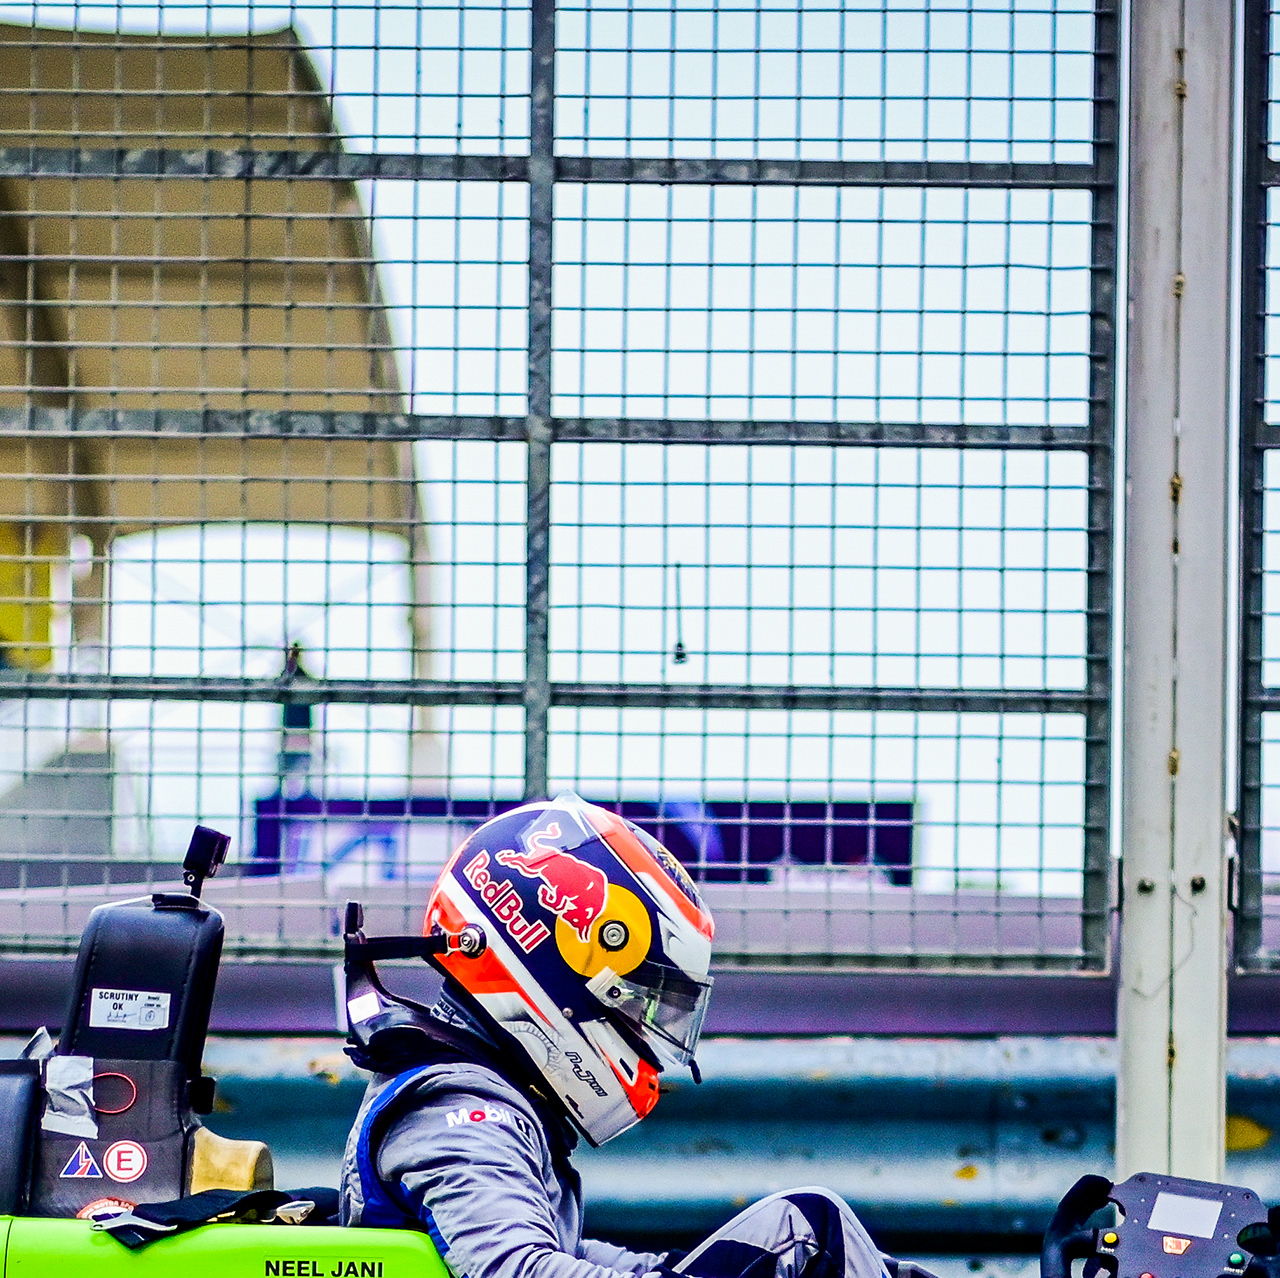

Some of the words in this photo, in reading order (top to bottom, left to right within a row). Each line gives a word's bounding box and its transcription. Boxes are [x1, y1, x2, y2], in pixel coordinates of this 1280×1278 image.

[99, 991, 139, 1002] SCRUTINY
[112, 1002, 124, 1011] OK
[445, 1104, 512, 1128] Mobil
[116, 1150, 133, 1171] E
[265, 1260, 324, 1277] NEEL
[331, 1261, 383, 1278] JANI
